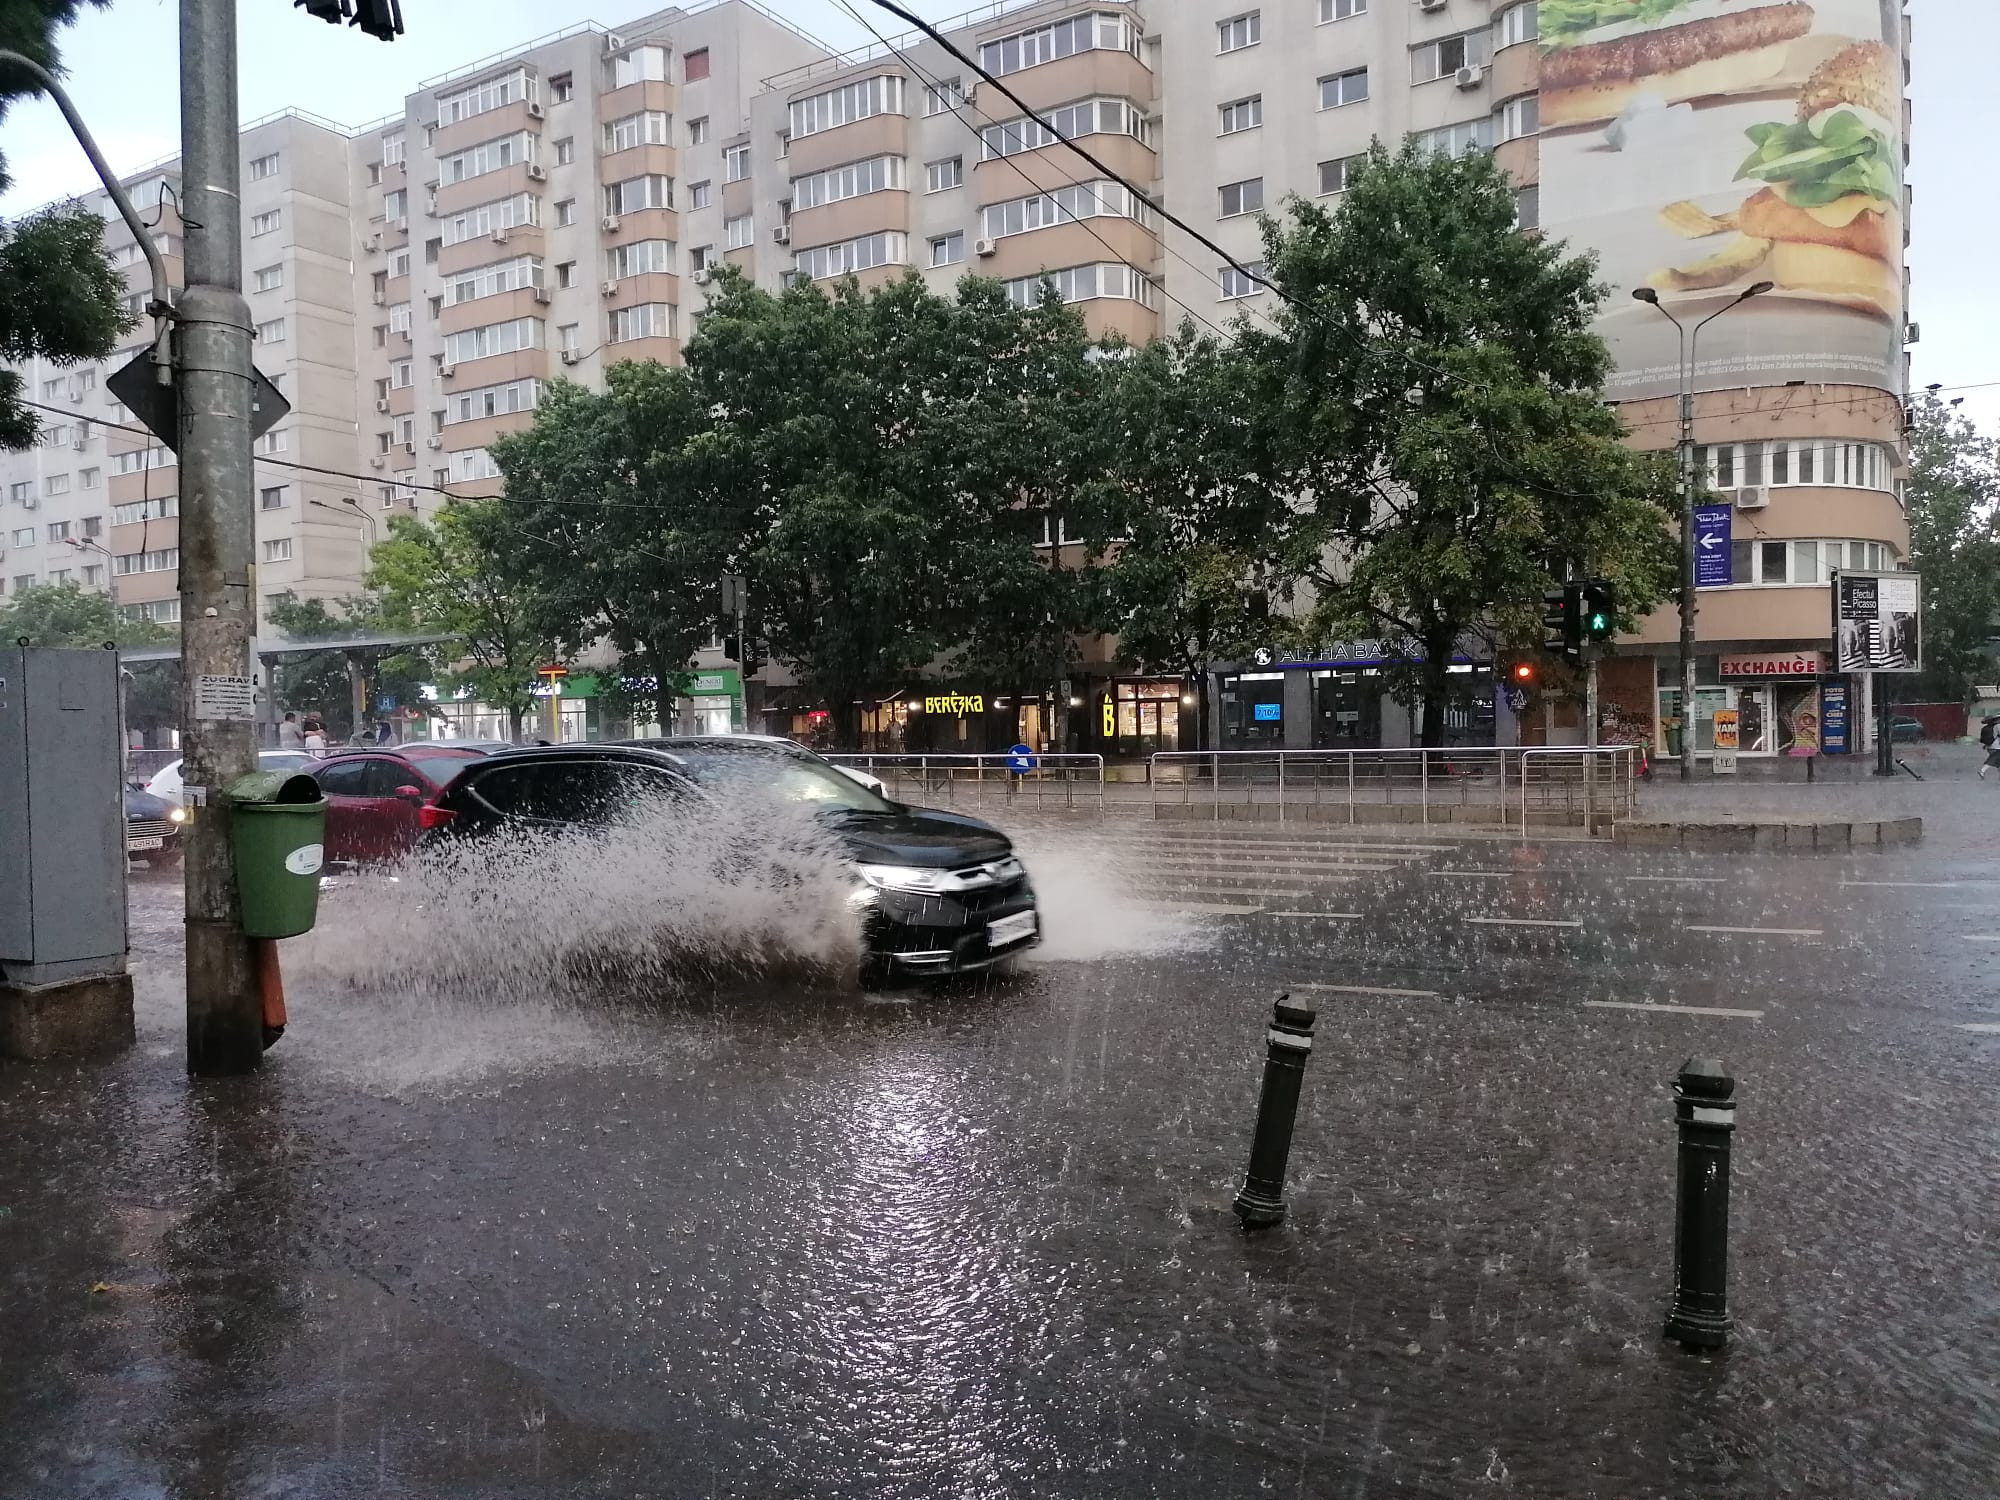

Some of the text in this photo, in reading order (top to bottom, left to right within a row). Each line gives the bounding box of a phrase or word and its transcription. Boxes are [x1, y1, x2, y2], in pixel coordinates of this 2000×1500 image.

[1852, 588, 1874, 599] Efectul
[1852, 599, 1877, 608] Picasso
[1720, 660, 1815, 674] EXCHANGE
[200, 676, 250, 684] ZUGRAV
